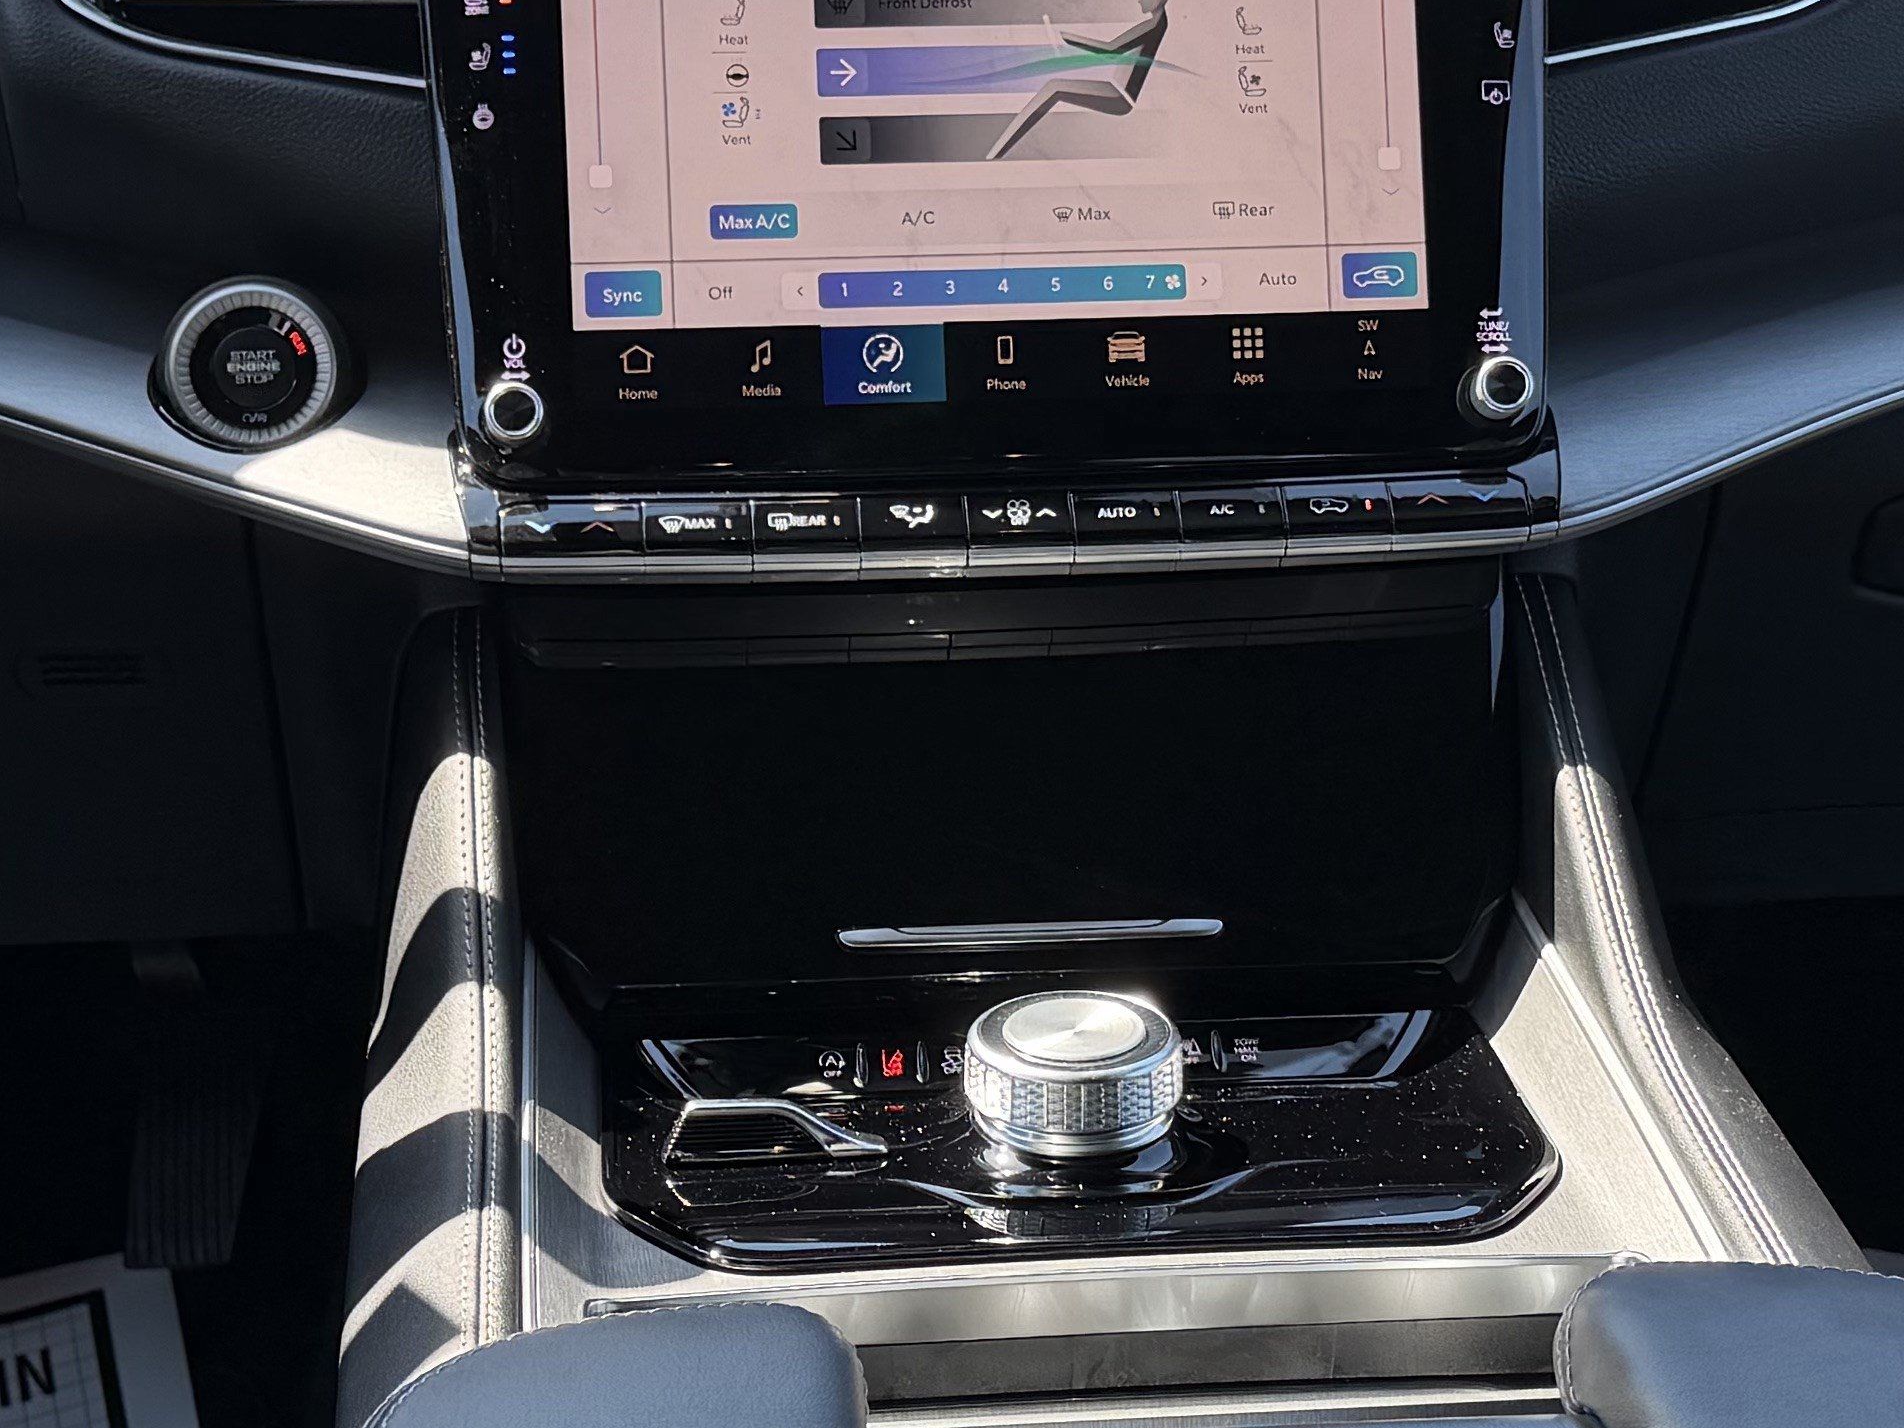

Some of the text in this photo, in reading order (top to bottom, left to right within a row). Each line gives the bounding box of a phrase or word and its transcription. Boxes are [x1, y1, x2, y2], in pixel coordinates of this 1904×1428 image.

[719, 33, 749, 46] Heat
[1235, 43, 1265, 55] Heat
[1239, 102, 1268, 114] Vent
[722, 134, 751, 146] Vent
[1078, 207, 1111, 221] Max
[1239, 202, 1275, 217] Rear
[719, 212, 790, 230] Max A/C
[901, 210, 935, 226] A/C
[1258, 271, 1297, 286] Auto
[893, 282, 903, 296] 2
[945, 281, 955, 295] 3
[998, 279, 1009, 294] 4
[1051, 277, 1061, 292] 5
[1103, 276, 1113, 291] 6
[1146, 275, 1154, 290] 7
[603, 288, 642, 306] Sync
[709, 285, 734, 301] Off
[1358, 319, 1379, 332] SW
[229, 349, 276, 361] START
[226, 361, 281, 374] ENGINE
[1358, 368, 1383, 380] Nav
[986, 378, 1027, 390] Phone
[1105, 374, 1150, 387] Vehicle
[1233, 372, 1264, 386] Apps
[619, 387, 658, 400] Home
[742, 384, 782, 397] Media
[858, 381, 912, 394] Comfort
[1097, 506, 1137, 519] AUTO
[1210, 503, 1235, 516] A/C
[685, 518, 716, 530] MAX
